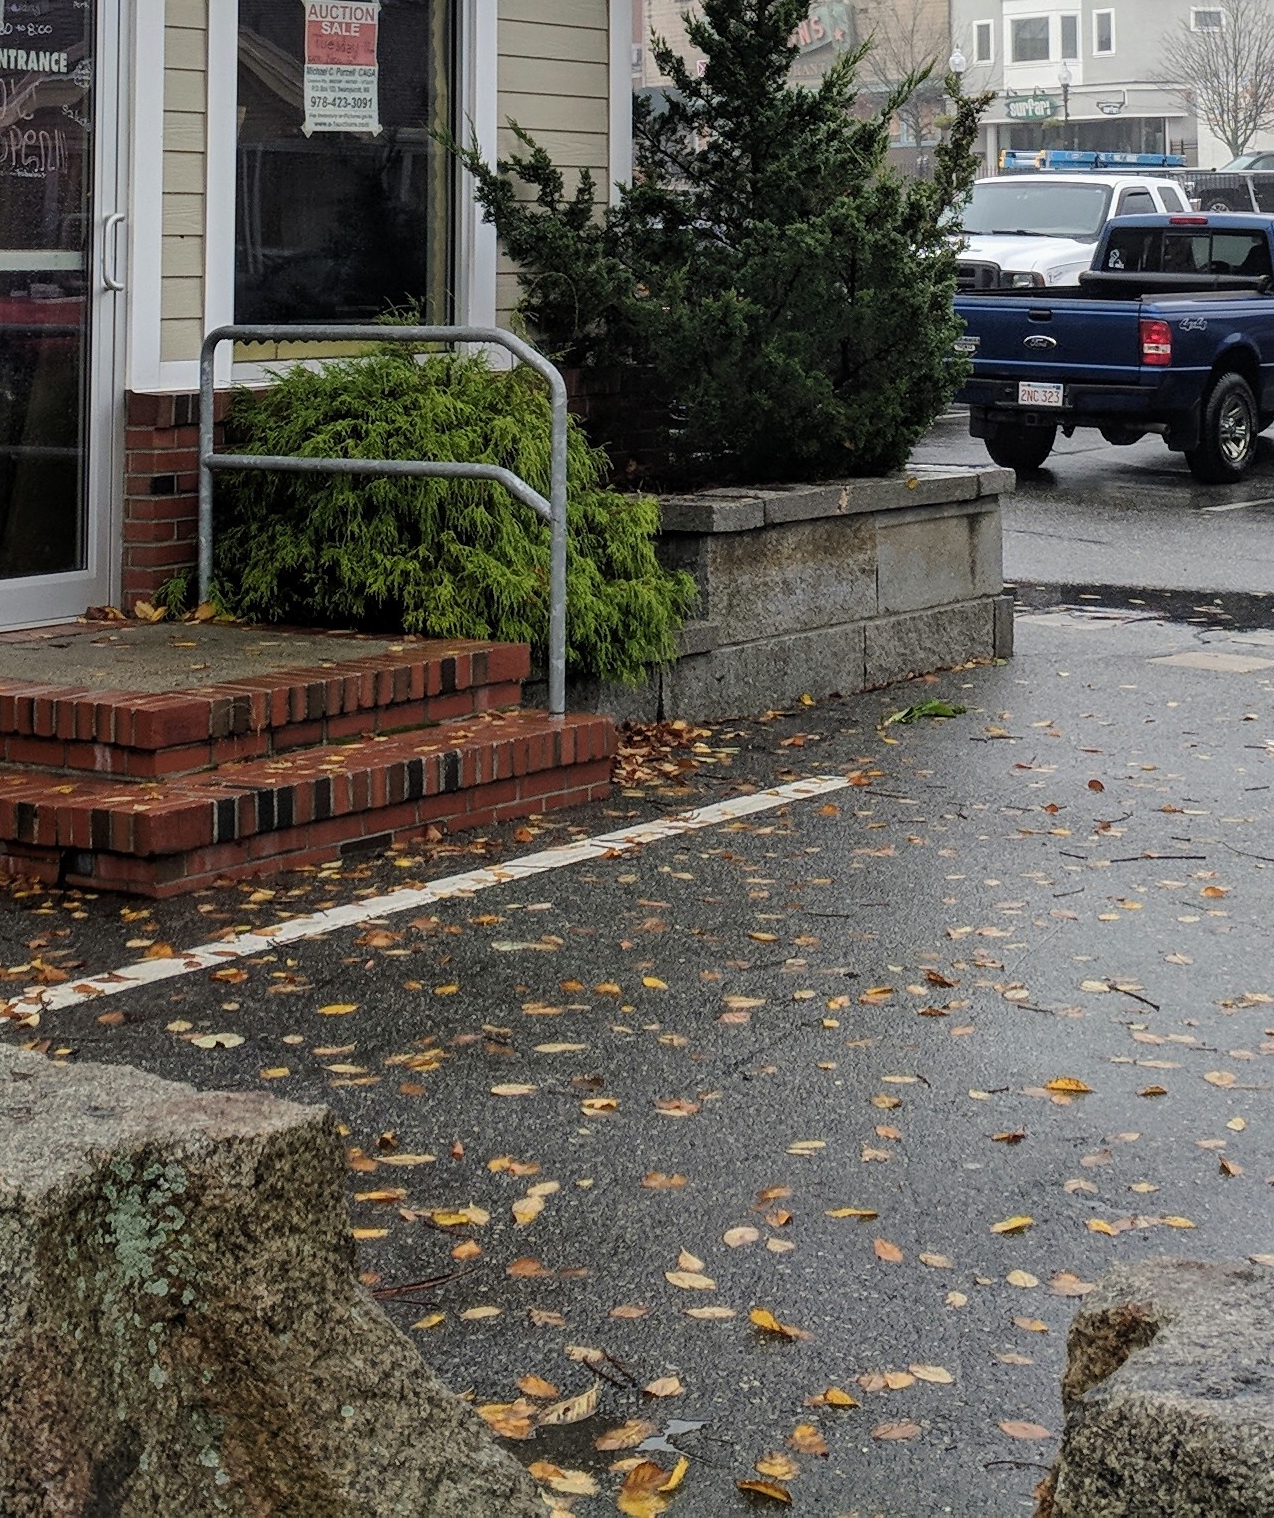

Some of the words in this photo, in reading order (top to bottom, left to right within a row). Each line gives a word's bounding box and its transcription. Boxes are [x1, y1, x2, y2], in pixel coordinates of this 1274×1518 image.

[308, 4, 374, 22] AUCTION
[321, 22, 360, 37] SALE
[311, 96, 373, 109] 978-423-3091
[1021, 389, 1039, 402] 2NC
[1041, 390, 1060, 404] 323
